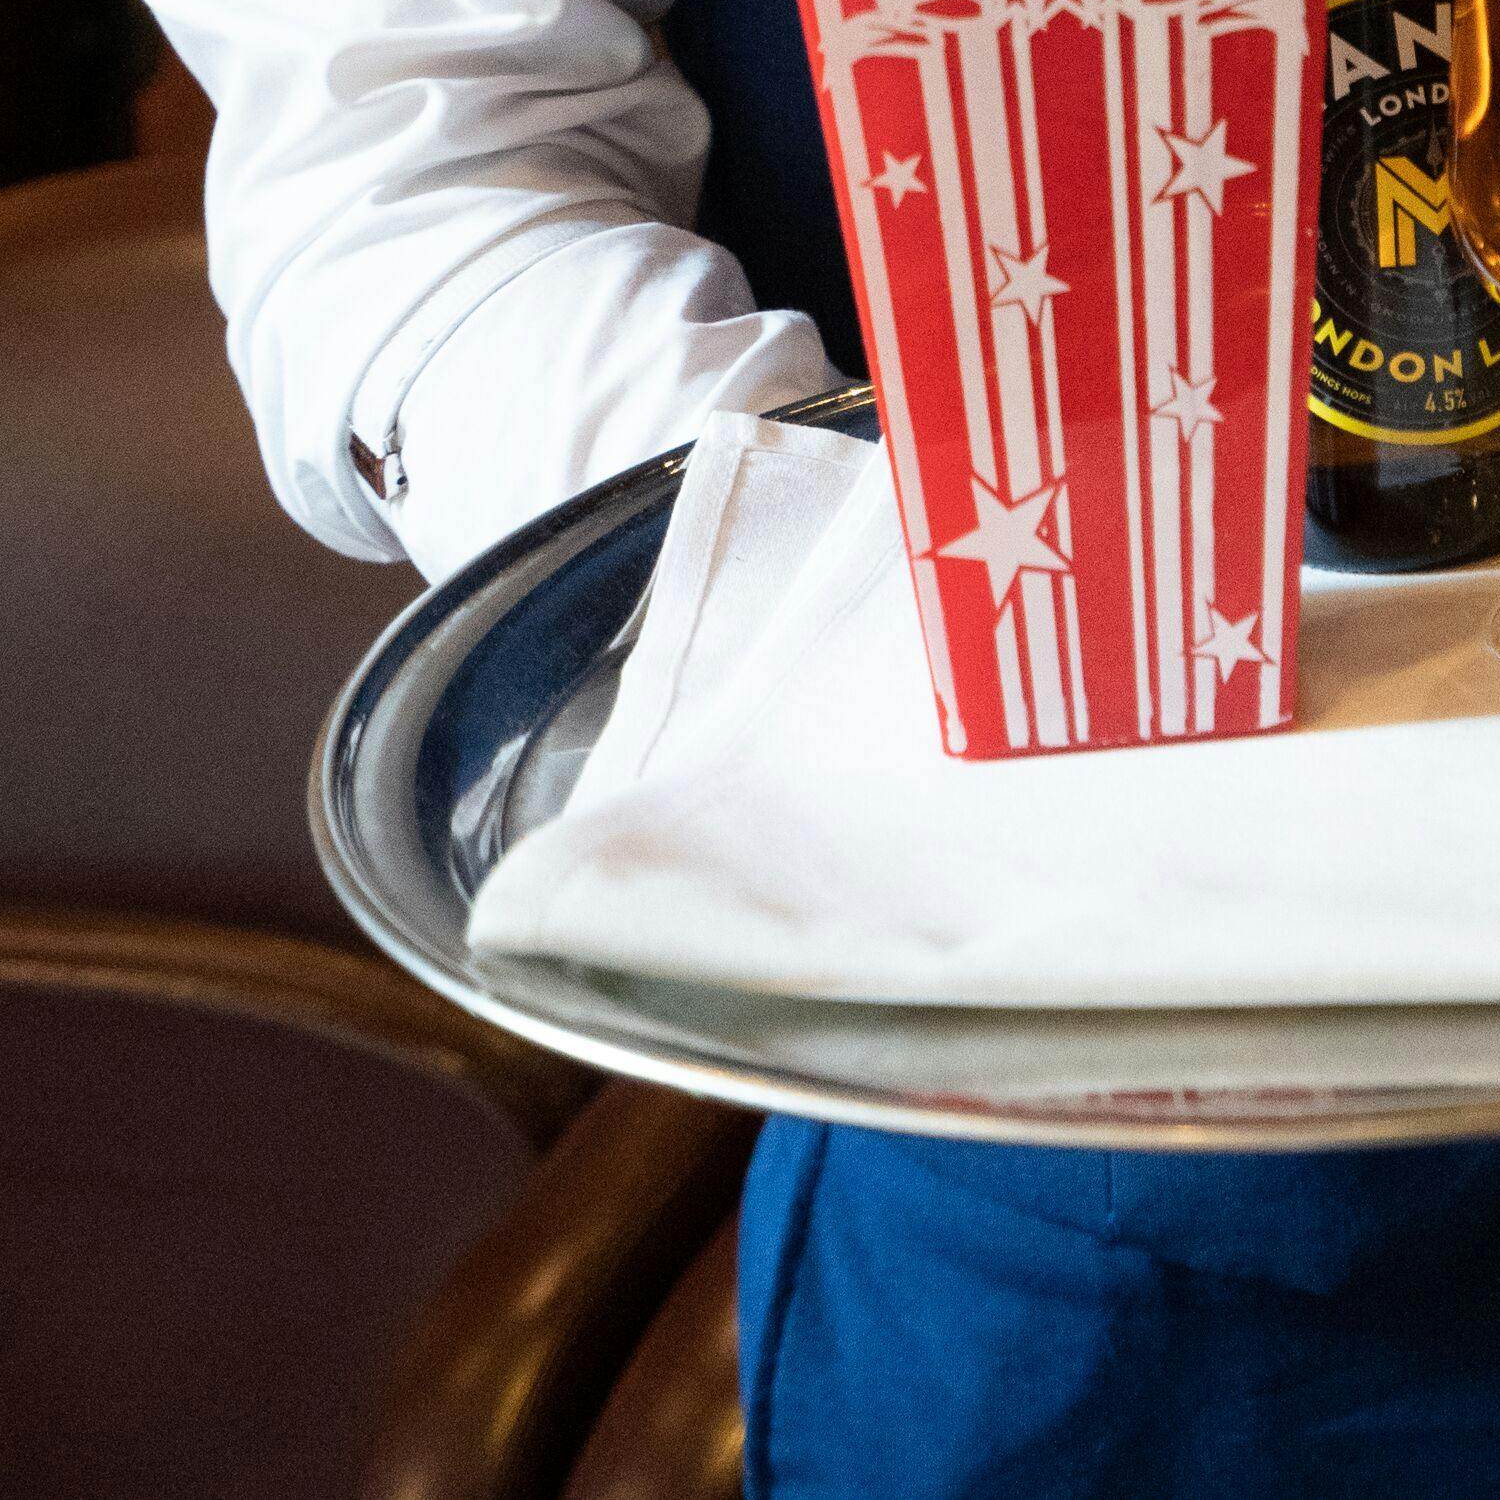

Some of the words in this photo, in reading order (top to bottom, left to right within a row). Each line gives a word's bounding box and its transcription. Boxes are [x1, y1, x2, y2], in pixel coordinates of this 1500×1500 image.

[1327, 2, 1453, 102] AN
[1359, 81, 1451, 127] LOND
[1424, 387, 1467, 413] 4.5%
